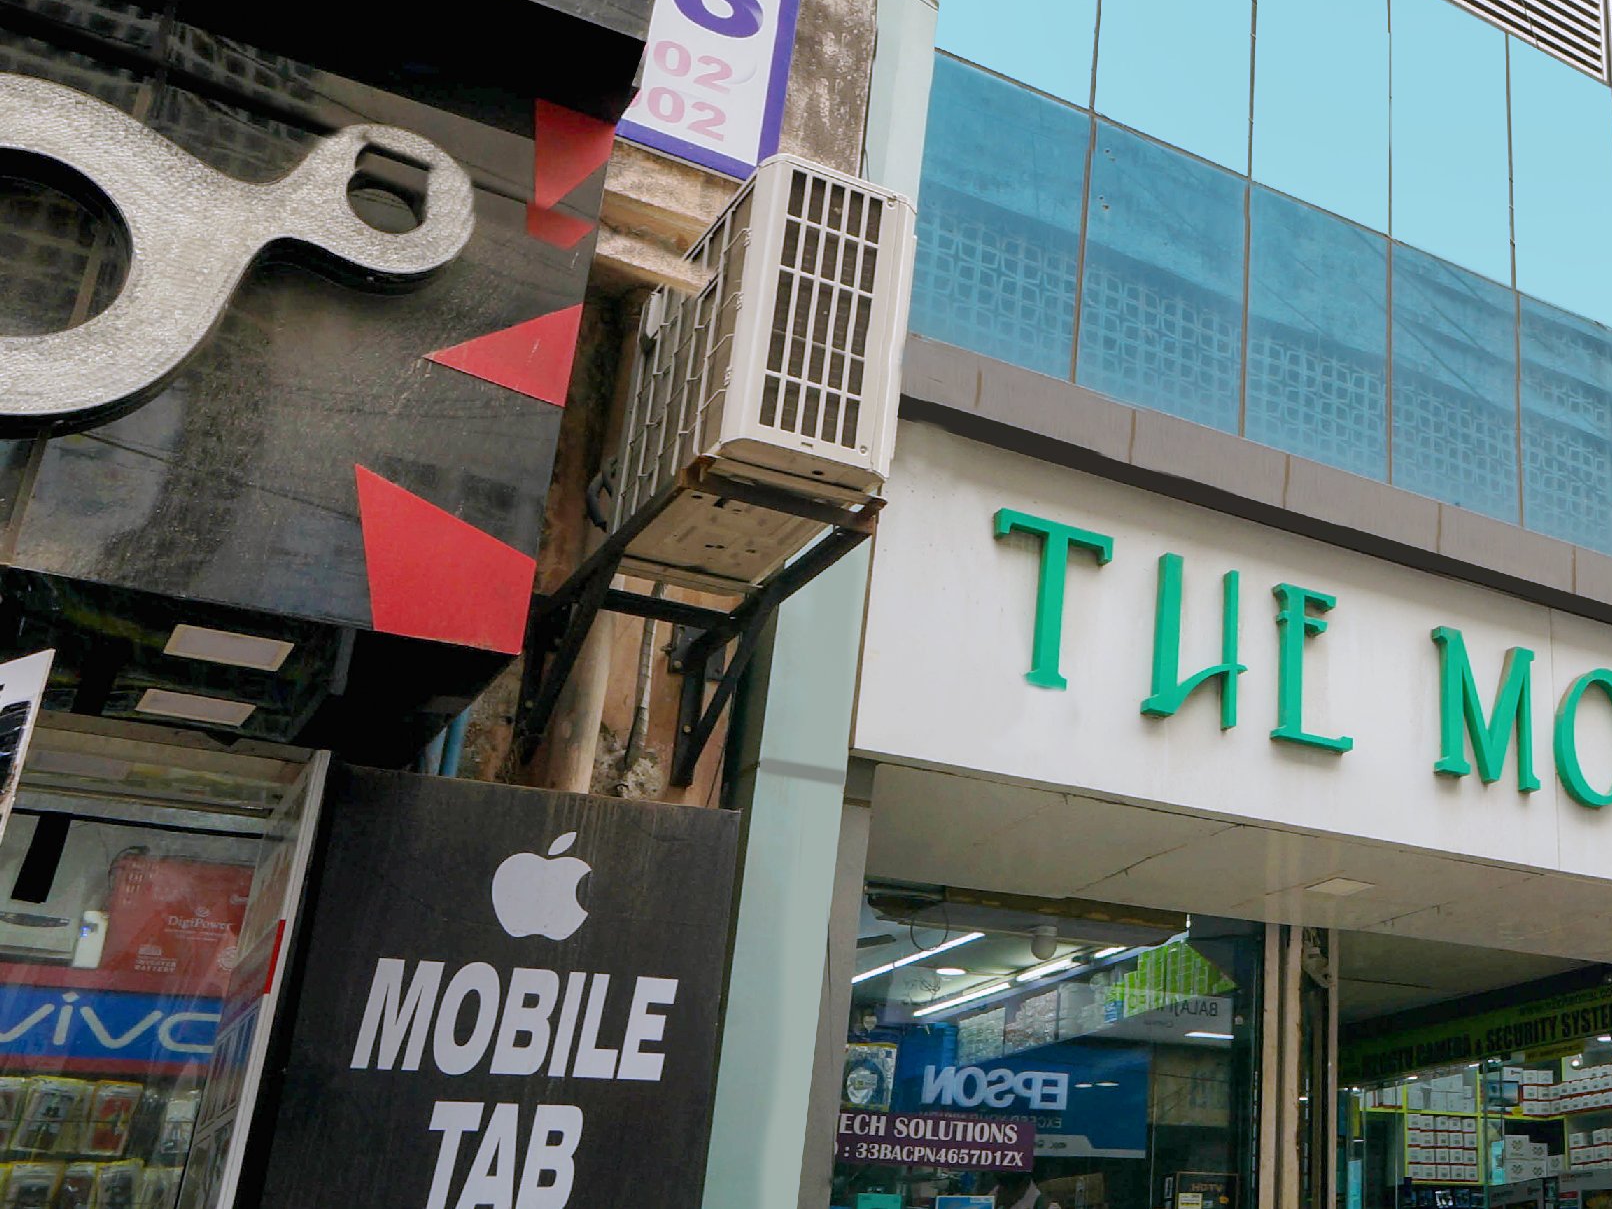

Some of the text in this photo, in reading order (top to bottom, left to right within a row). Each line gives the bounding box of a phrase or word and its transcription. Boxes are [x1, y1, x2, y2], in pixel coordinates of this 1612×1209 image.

[632, 86, 728, 142] 02
[993, 507, 1354, 754] THE
[350, 957, 679, 1082] MOBILE
[1486, 1016, 1557, 1053] SECURITY
[426, 1100, 584, 1209] TAB
[838, 1113, 1018, 1144] ECH SOLUTIONS
[855, 1143, 1024, 1167] 33BACPN4657D1ZX
